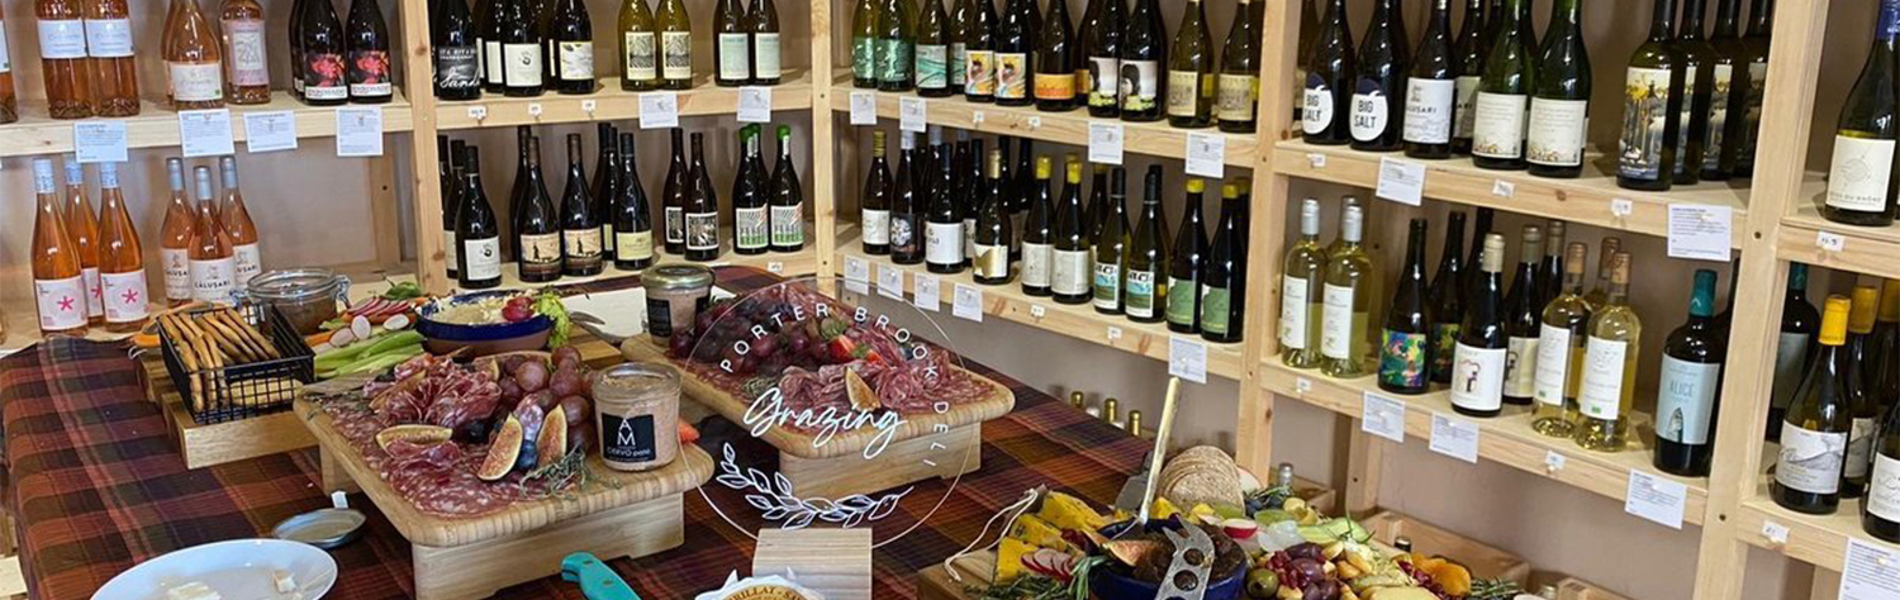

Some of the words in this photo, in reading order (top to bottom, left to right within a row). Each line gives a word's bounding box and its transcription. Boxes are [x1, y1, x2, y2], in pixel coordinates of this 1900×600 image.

[1306, 94, 1319, 107] BIG
[1358, 100, 1374, 113] BIG
[1354, 114, 1377, 129] SALT
[719, 302, 830, 374] PORTER
[853, 306, 939, 379] BROOK
[923, 401, 950, 468] DELI
[743, 386, 908, 460] Grazing
